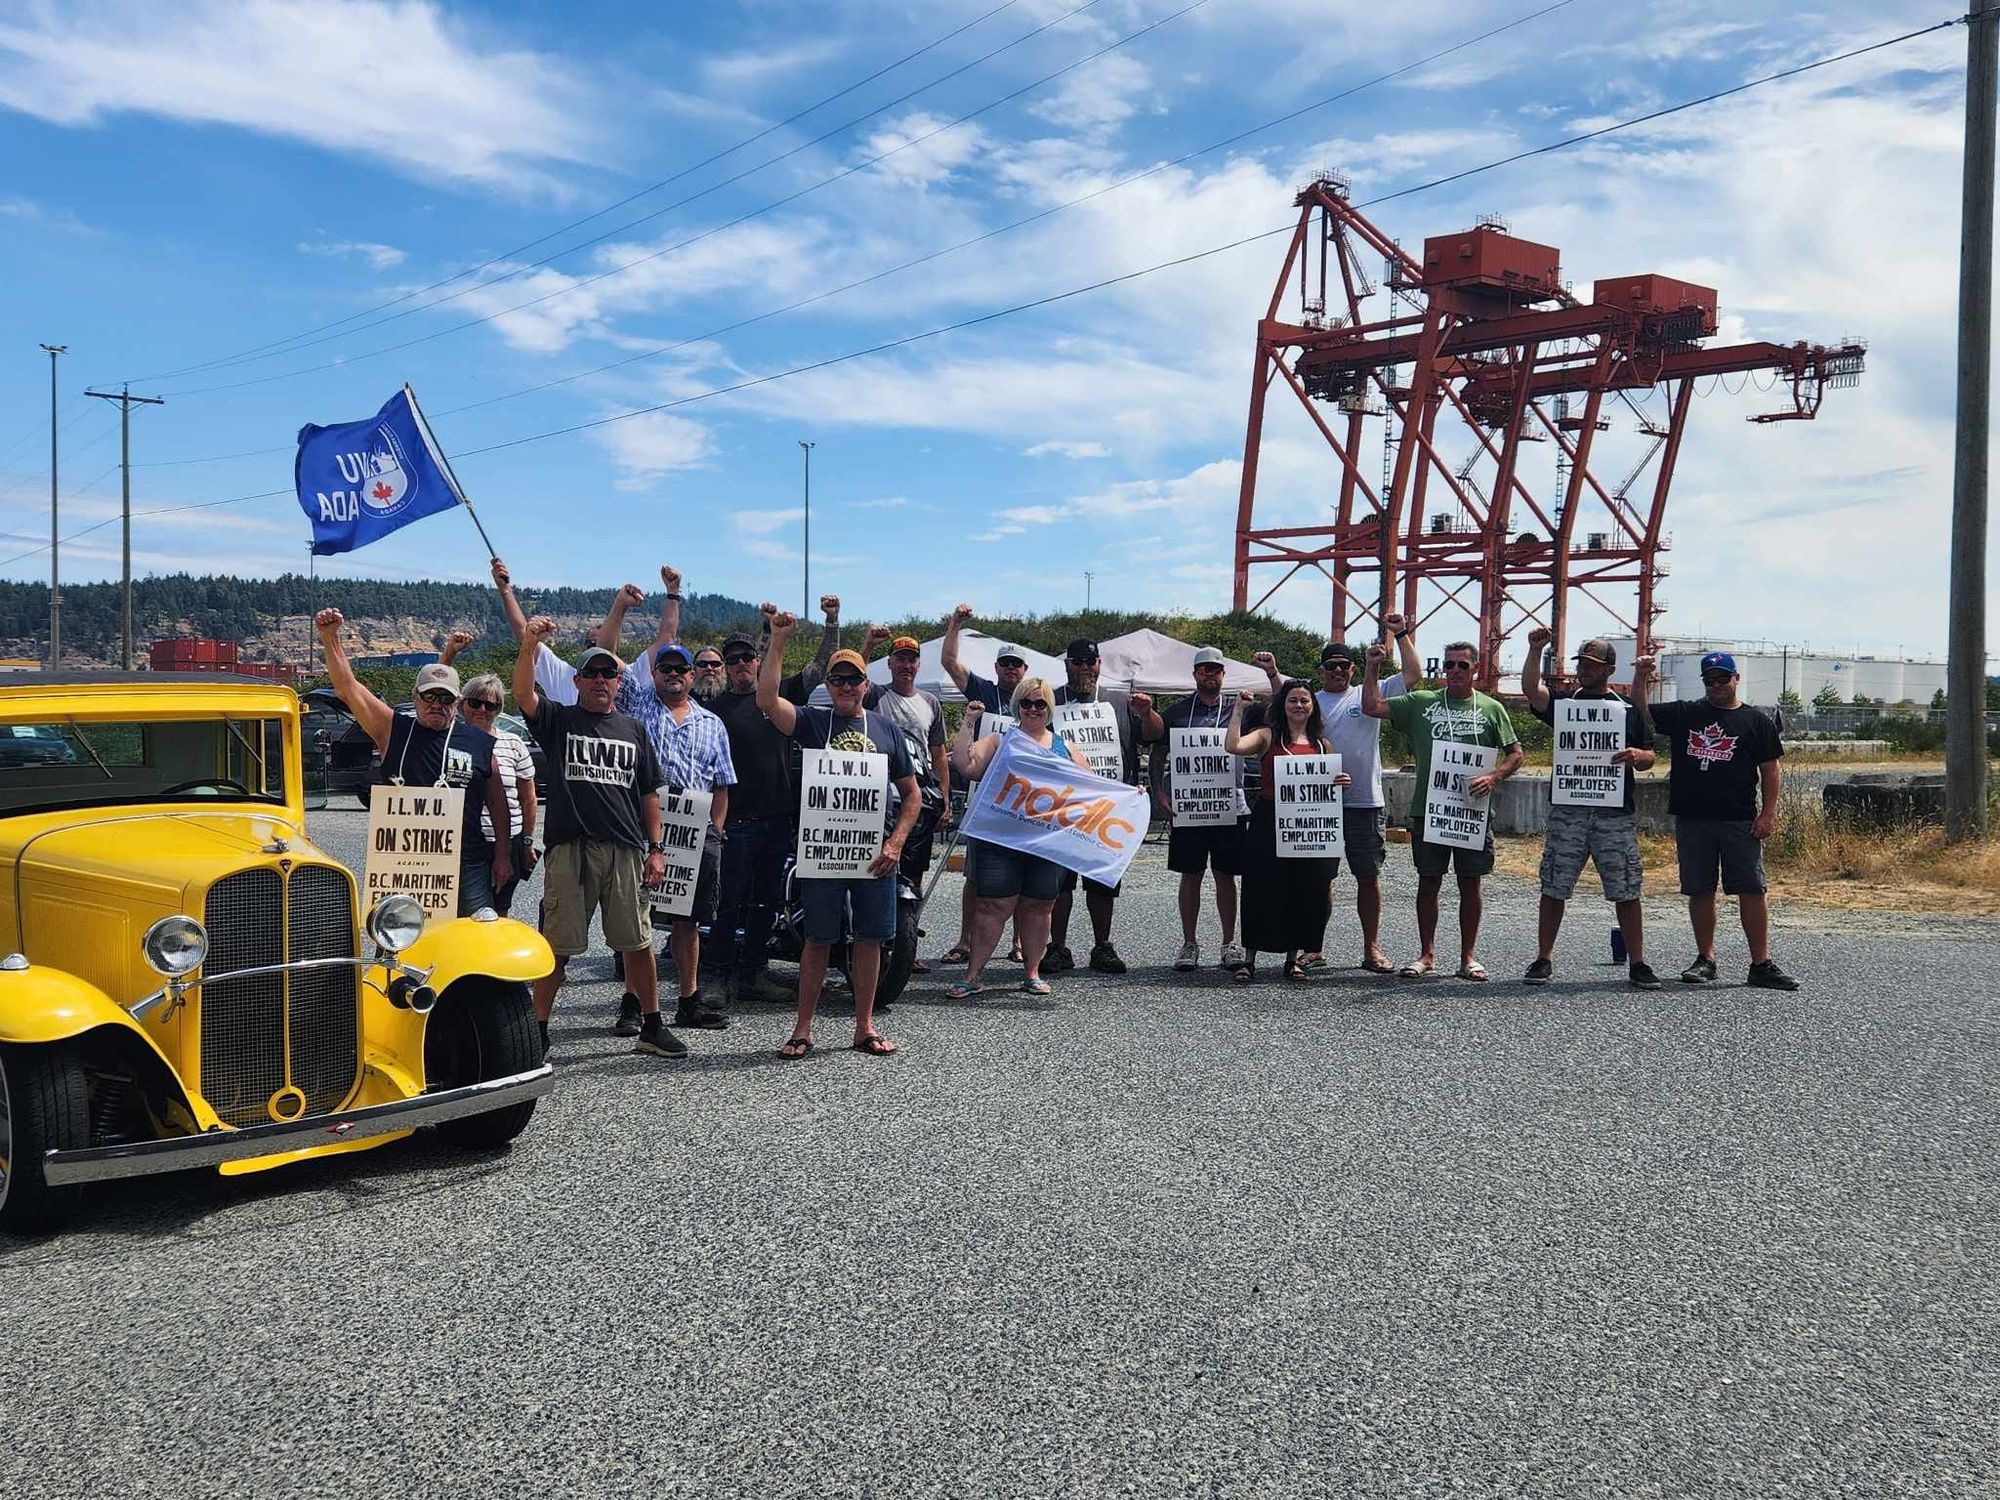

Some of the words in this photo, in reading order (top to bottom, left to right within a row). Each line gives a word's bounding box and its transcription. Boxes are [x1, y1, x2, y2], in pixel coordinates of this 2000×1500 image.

[1061, 729, 1075, 742] ON
[1079, 726, 1114, 742] STRIKE
[1560, 731, 1575, 749] ON
[1580, 732, 1619, 750] STRIKE
[567, 738, 633, 771] ILWU
[1175, 756, 1190, 773] ON
[1194, 756, 1230, 773] STRIKE
[1556, 764, 1573, 776] B.C.
[1573, 765, 1621, 777] MARITIME
[568, 764, 632, 785] JURISDICTION
[1433, 770, 1449, 791] ON
[1280, 785, 1295, 802] ON
[1299, 783, 1337, 802] STRIKE
[1558, 778, 1616, 791] EMPLOYERS
[808, 786, 827, 808] ON
[832, 787, 880, 811] STRIKE
[1174, 788, 1190, 800] B.C.
[1190, 788, 1233, 800] MARITIME
[1570, 791, 1605, 799] ASSOCIATION
[1177, 800, 1230, 812] EMPLOYERS
[1428, 803, 1443, 816] B.C.
[1443, 805, 1485, 822] MARITIME
[1019, 814, 1046, 829] Duncan
[1279, 818, 1294, 829] B.C.
[1294, 817, 1340, 829] MARITIME
[1430, 816, 1481, 835] EMPLOYERS
[375, 828, 397, 851] ON
[402, 828, 454, 853] STRIKE
[660, 822, 700, 849] TRIKE
[802, 828, 822, 842] B.C.
[822, 829, 880, 845] MARITIME
[1281, 831, 1337, 842] EMPLOYERS
[805, 845, 873, 860] EMPLOYERS
[817, 862, 858, 870] ASSOCIATION
[368, 873, 391, 889] B.C.
[392, 873, 454, 890] MARITIME
